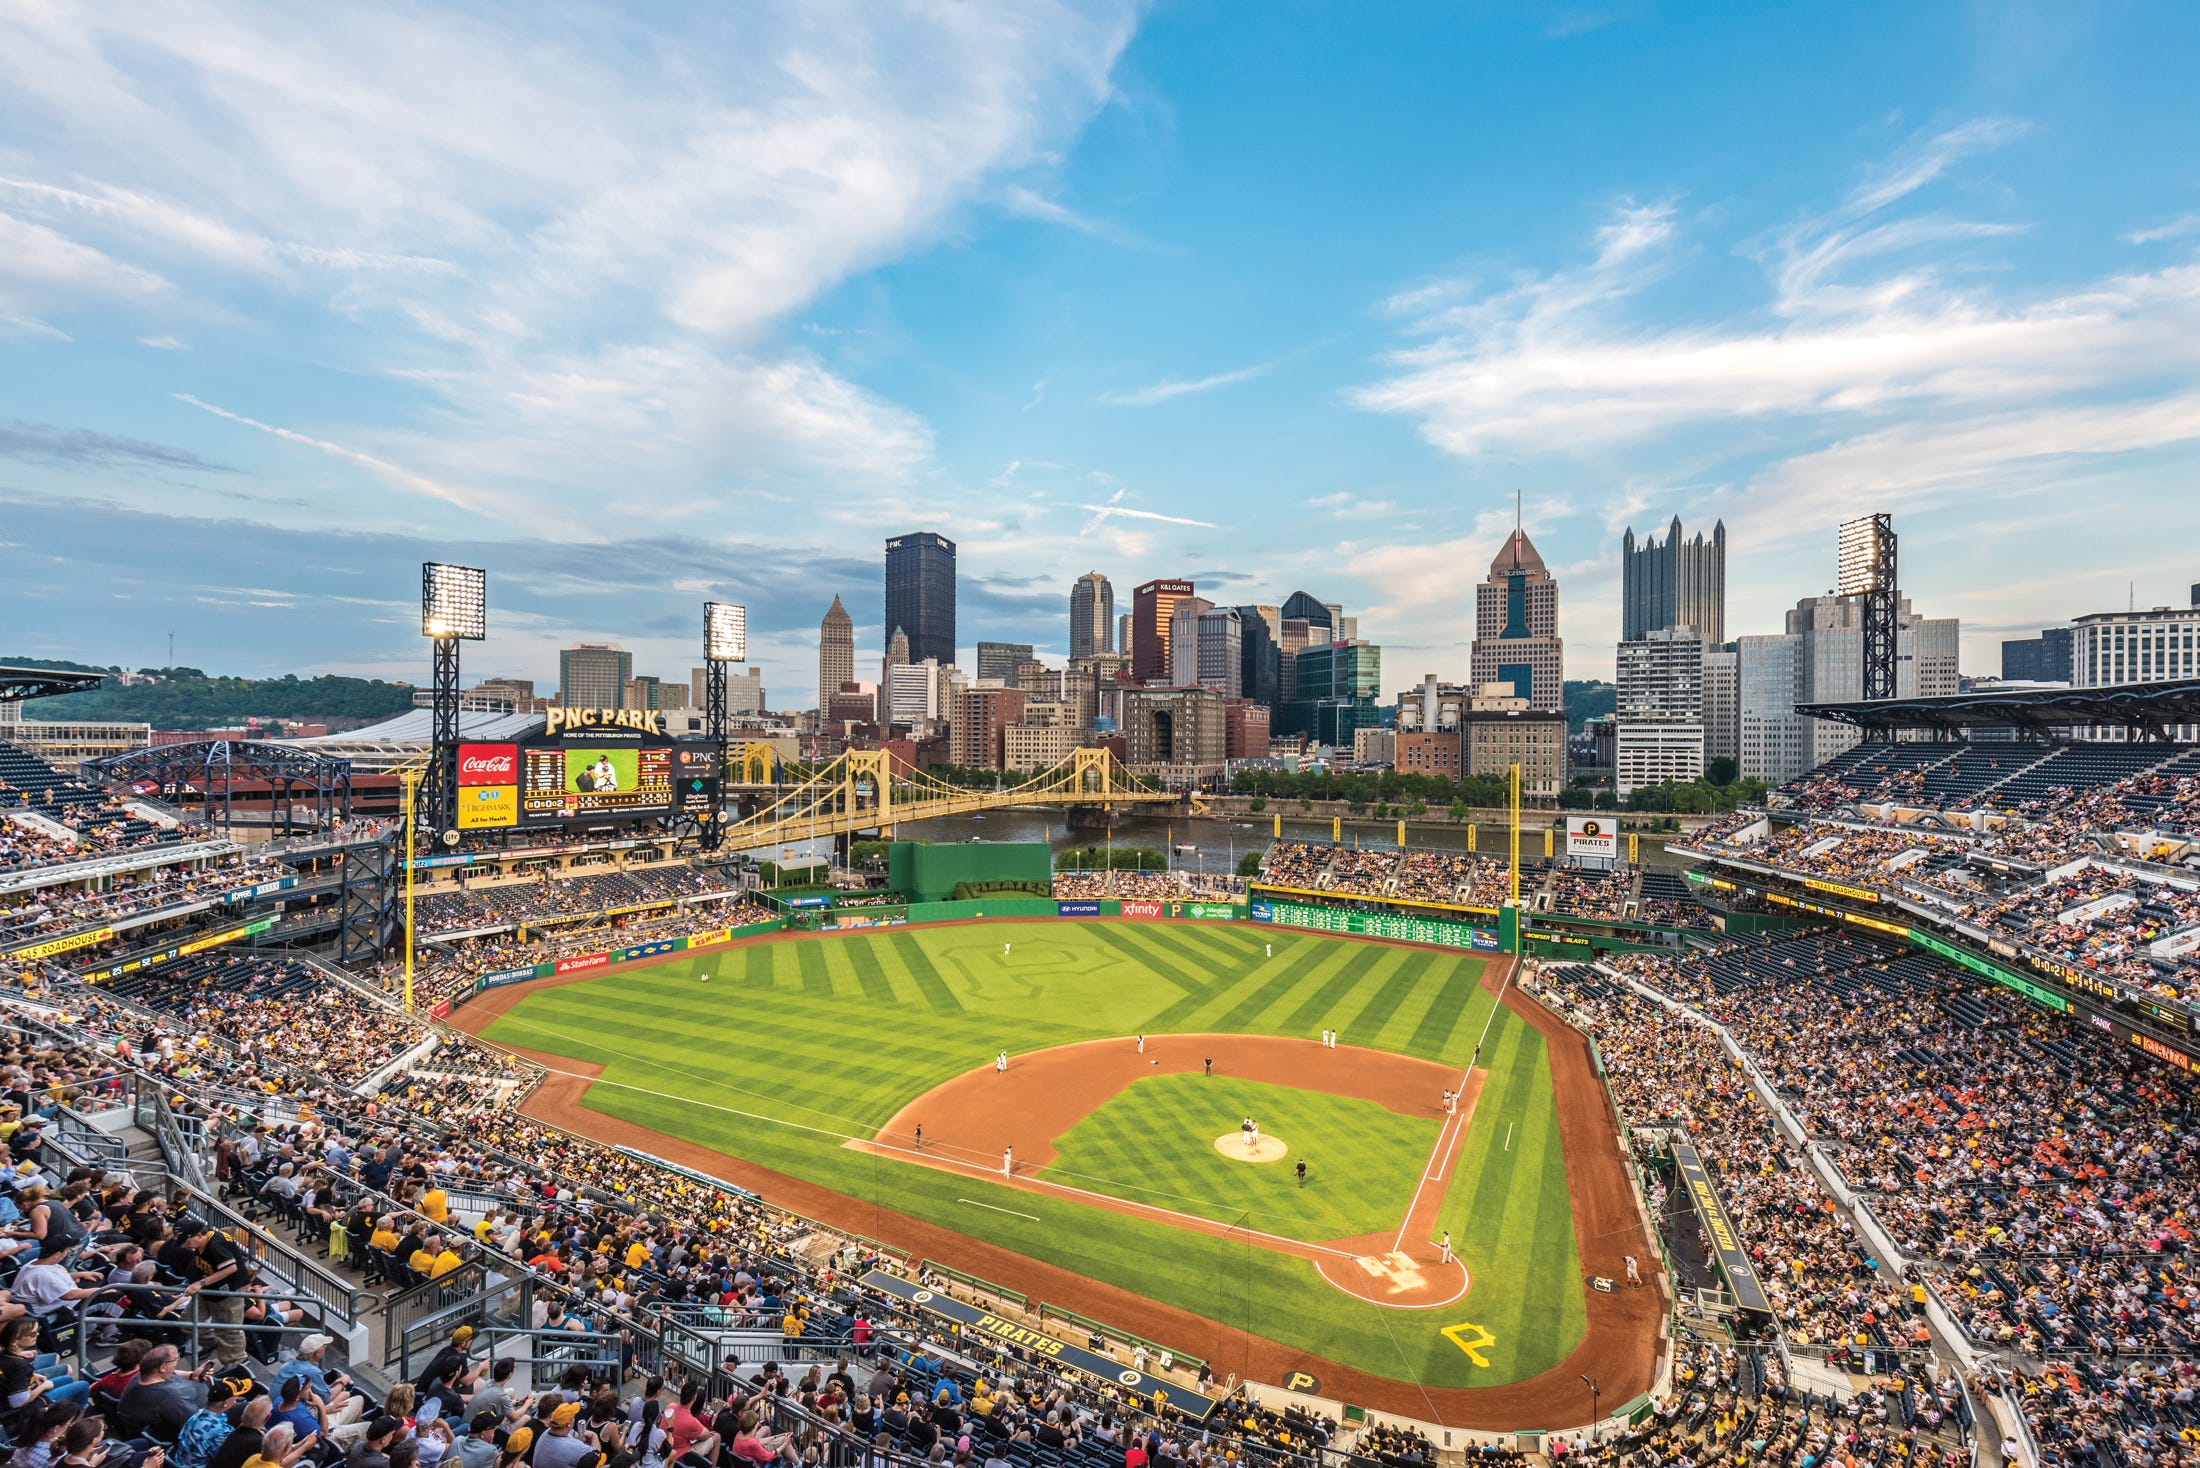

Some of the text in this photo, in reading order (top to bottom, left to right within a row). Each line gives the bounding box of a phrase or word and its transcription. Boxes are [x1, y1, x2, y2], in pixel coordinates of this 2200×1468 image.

[546, 707, 660, 736] PNC PARK
[692, 752, 715, 762] PNC
[1588, 825, 1596, 834] P
[232, 890, 252, 901] KOPPERS
[1814, 881, 1867, 898] TEXAS ROADHOUSE
[1124, 903, 1160, 916] xfinity
[1172, 904, 1181, 917] P
[18, 933, 97, 960] XAS ROADHOUSE
[97, 950, 177, 981] BALL 25 STRIKE 52 TOTAL 77
[571, 957, 606, 969] State Farm
[2035, 957, 2040, 968] 0
[2044, 961, 2050, 972] 0
[2054, 965, 2060, 976] 2
[489, 973, 510, 983] BORDAS
[513, 969, 533, 979] BORDAS
[2042, 992, 2061, 1007] StubHub
[2103, 987, 2113, 996] LOB
[2066, 1004, 2112, 1032] 12 PANIK
[2146, 1038, 2185, 1066] GIANTS
[1693, 1180, 1710, 1196] PARK
[1699, 1196, 1716, 1209] PNC
[1710, 1216, 1736, 1250] WELCOME
[786, 1327, 796, 1336] 22
[976, 1315, 1064, 1356] PIRATES
[1440, 1322, 1496, 1368] P
[1288, 1372, 1314, 1392] P
